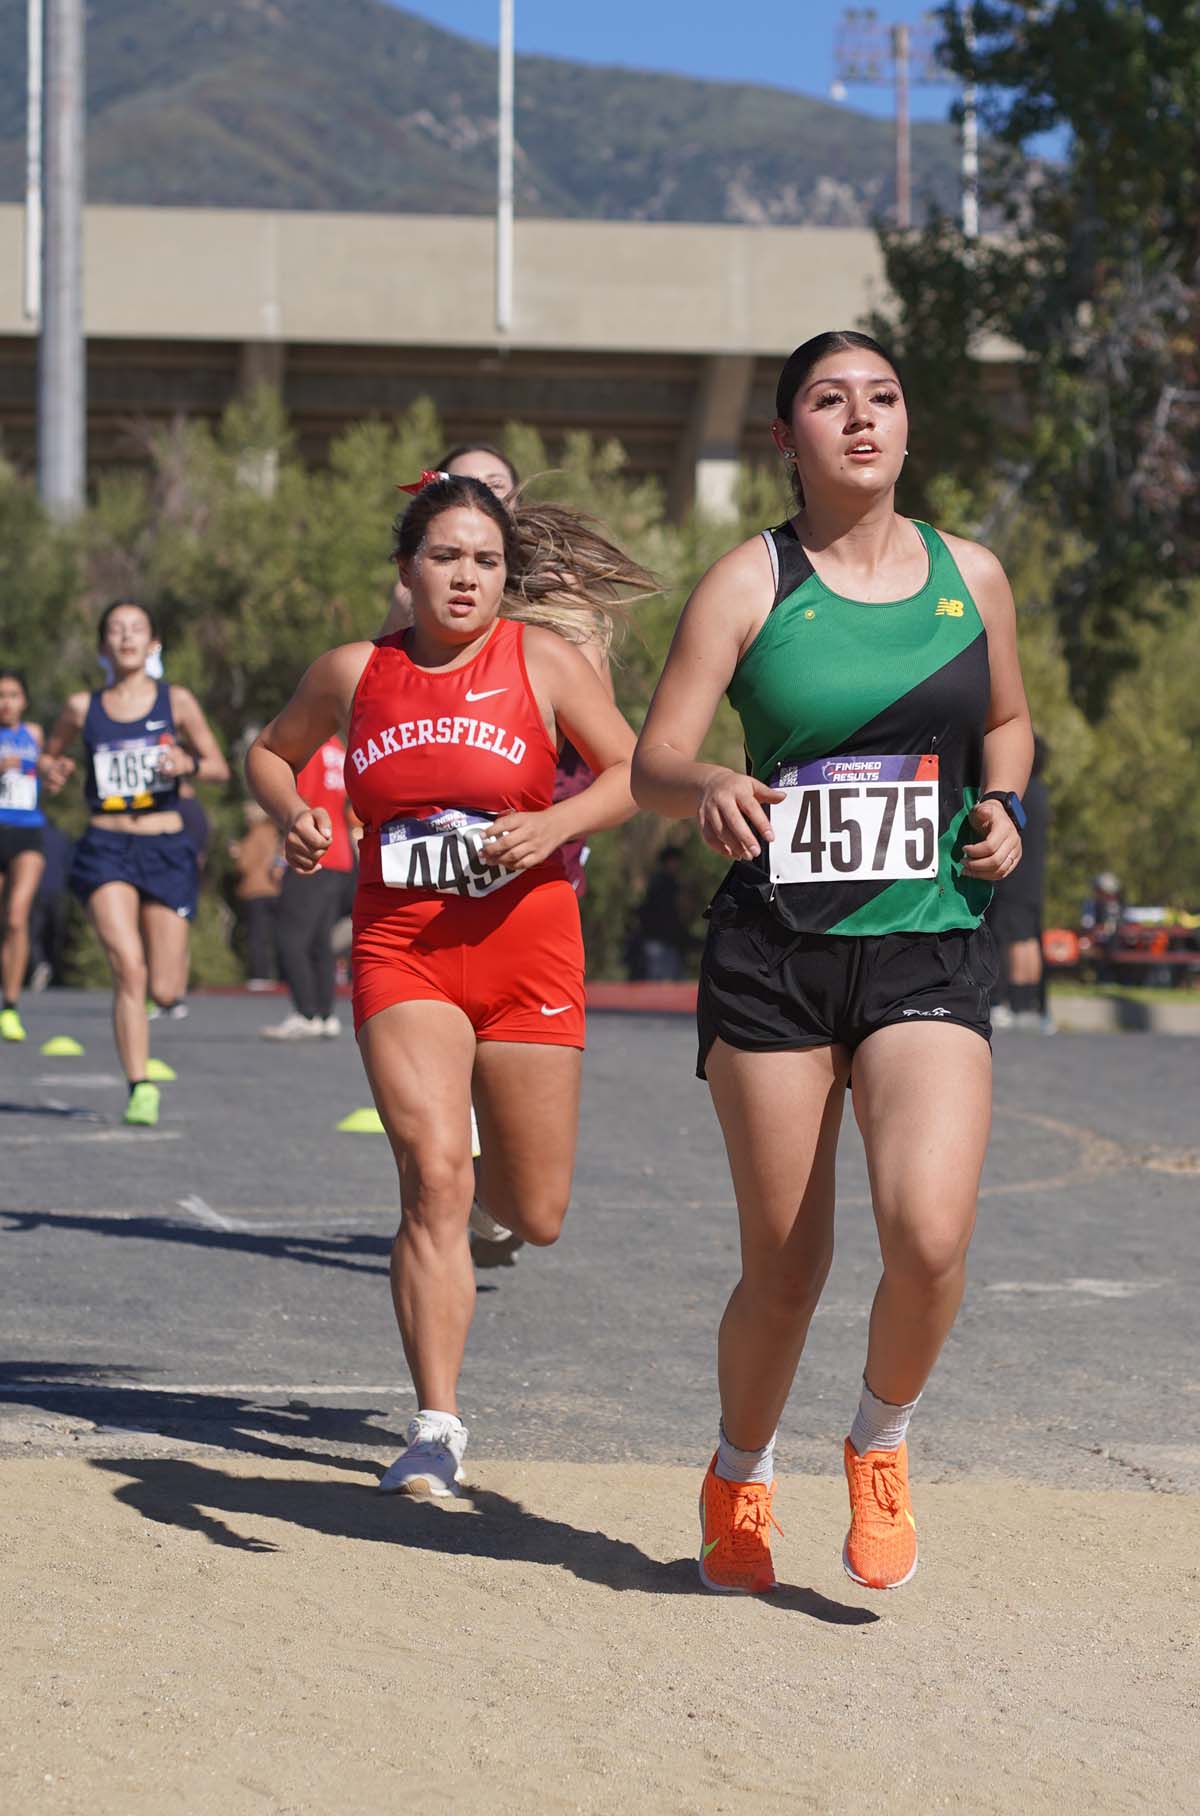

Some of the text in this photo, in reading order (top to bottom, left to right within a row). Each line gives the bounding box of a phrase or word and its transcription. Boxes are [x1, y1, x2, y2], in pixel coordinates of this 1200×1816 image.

[351, 716, 527, 775] BAKERSFIELD
[835, 761, 882, 771] FINISHED
[108, 752, 172, 790] 465
[832, 772, 880, 782] RESULTS
[790, 786, 934, 873] 4575
[406, 828, 515, 897] 449
